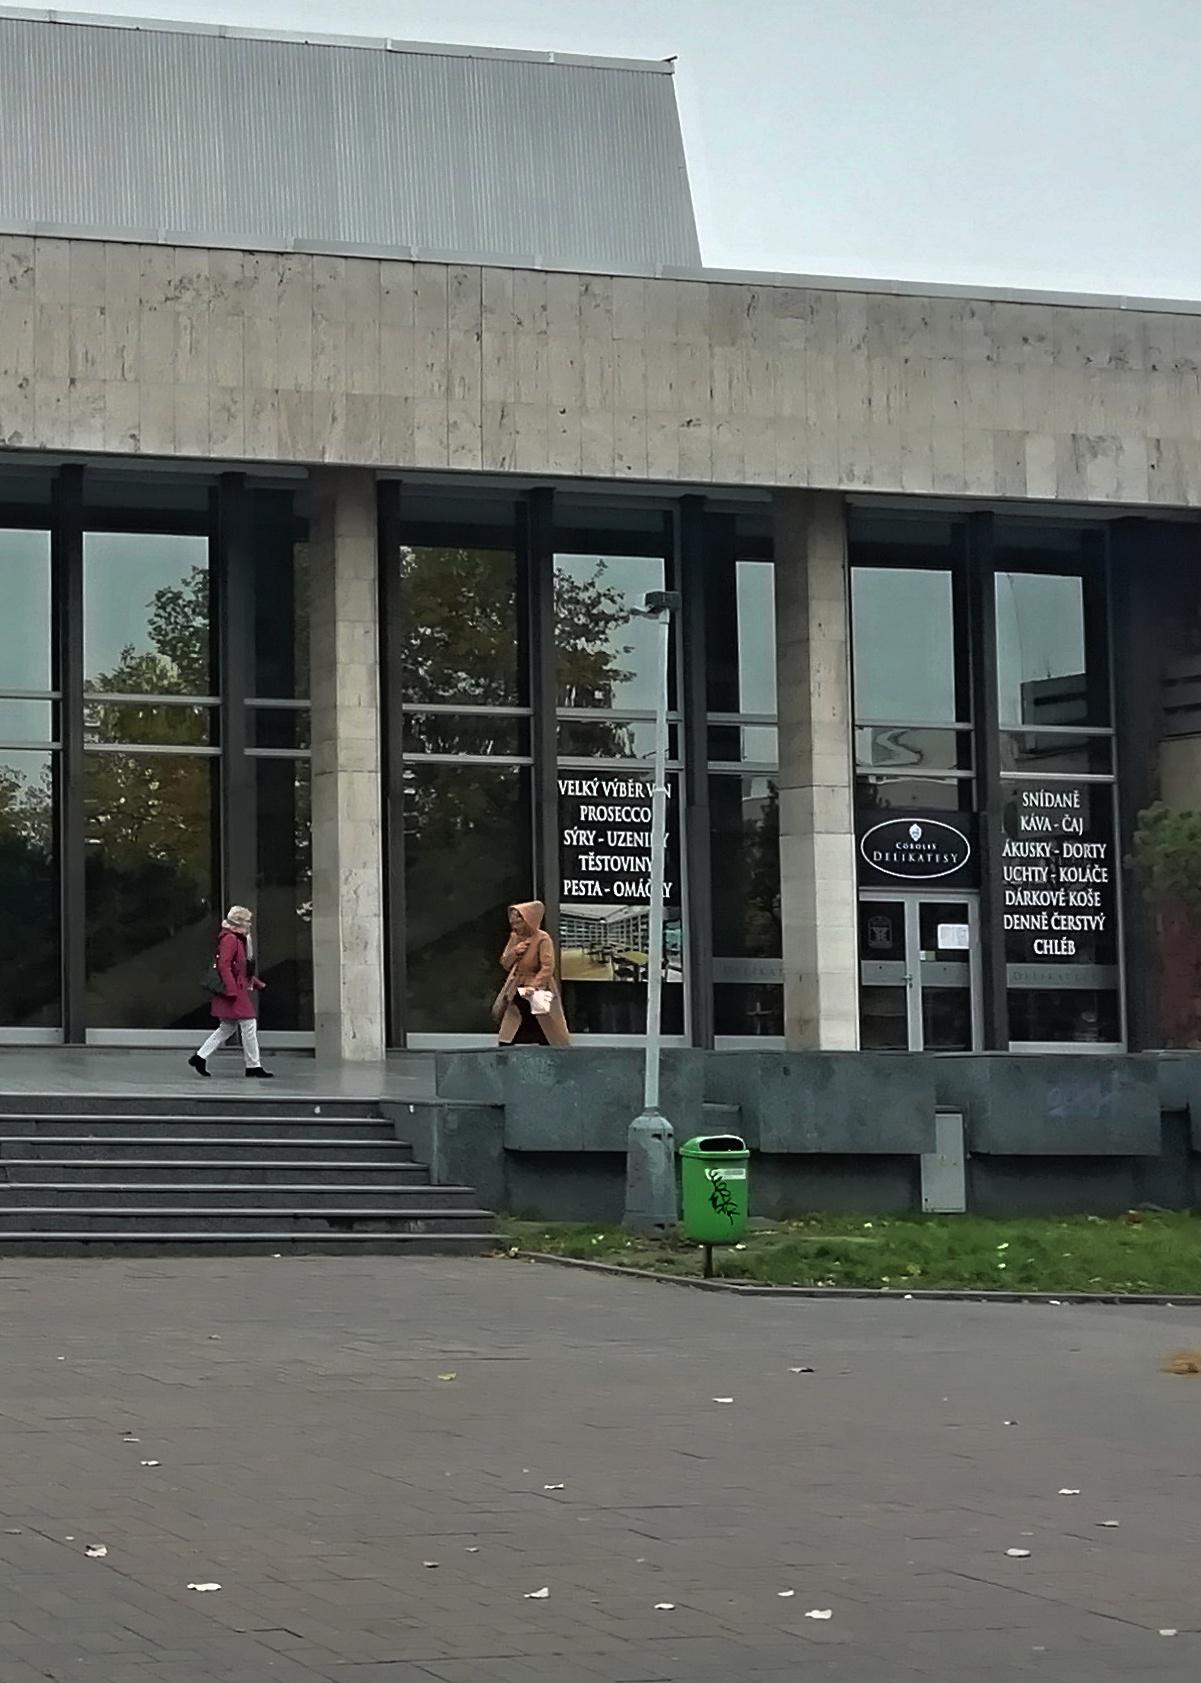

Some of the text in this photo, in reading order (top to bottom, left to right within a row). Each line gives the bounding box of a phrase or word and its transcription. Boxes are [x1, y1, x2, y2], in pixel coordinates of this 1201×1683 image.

[558, 777, 671, 798] VELKÝ VÝBĚR VN
[1022, 788, 1080, 808] SNÍDANĚ
[580, 805, 651, 823] PROSECCO
[1020, 812, 1052, 831] KÁVA
[1062, 814, 1083, 836] ČAJ
[563, 826, 596, 846] SÝRY
[607, 830, 669, 848] UZENIY
[873, 850, 958, 863] DELIKATESY
[1002, 838, 1051, 857] ÁKUSKY
[1063, 842, 1106, 859] DORTY
[578, 852, 652, 872] TĚSTOVINY
[1003, 866, 1048, 882] UCHTY
[1060, 864, 1109, 883] KOLÁČE
[563, 879, 602, 897] PESTA
[1005, 887, 1101, 907] DÁRKOVÉ KOŠE
[1003, 911, 1106, 931] DENNĚ ČERSTVÝ
[1033, 936, 1076, 955] CHLÉB
